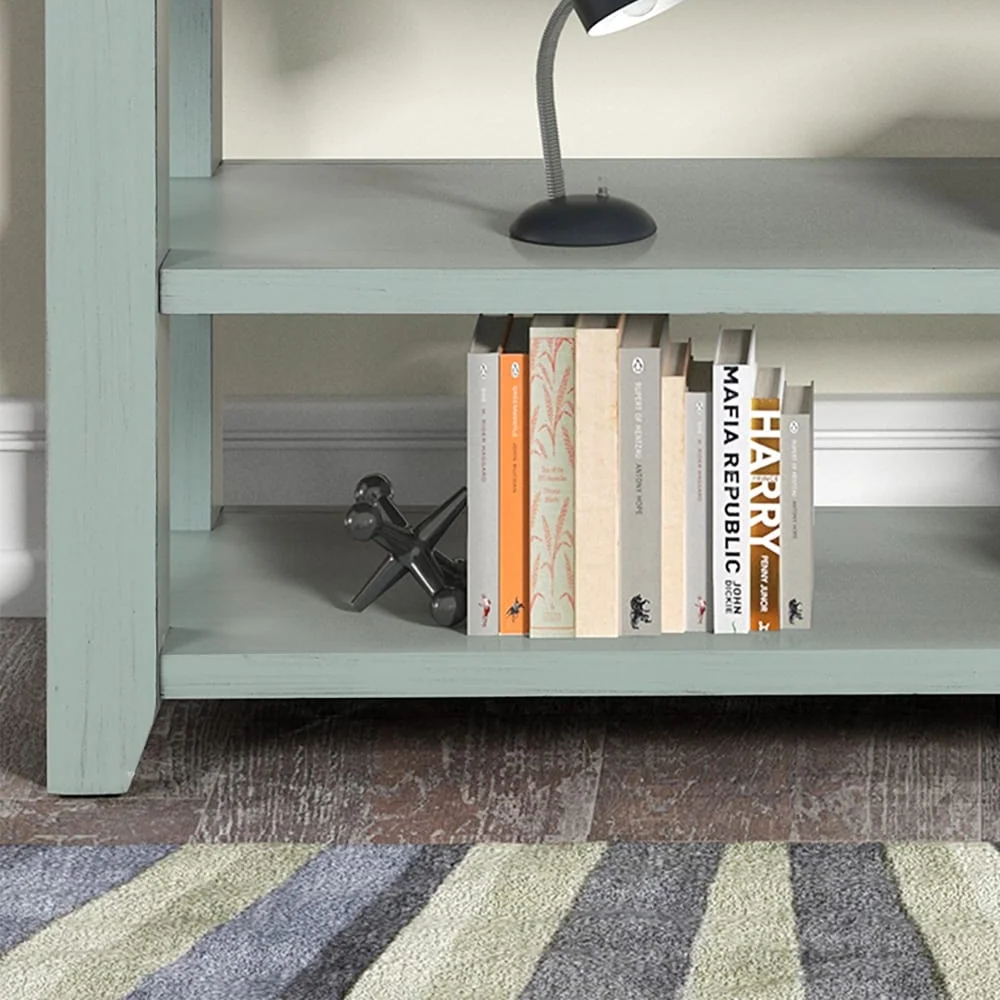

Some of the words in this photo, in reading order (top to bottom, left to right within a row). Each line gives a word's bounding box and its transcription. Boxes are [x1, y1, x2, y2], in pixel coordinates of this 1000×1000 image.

[723, 366, 740, 445] MAFIA
[635, 463, 643, 493] ANTONY
[750, 410, 781, 555] HARRY
[635, 495, 643, 515] HOPE
[723, 453, 741, 573] REPUBLIC
[760, 554, 769, 583] PENNY
[724, 580, 734, 614] DICKIE
[732, 580, 742, 614] JOHN
[760, 584, 769, 613] JUNOR
